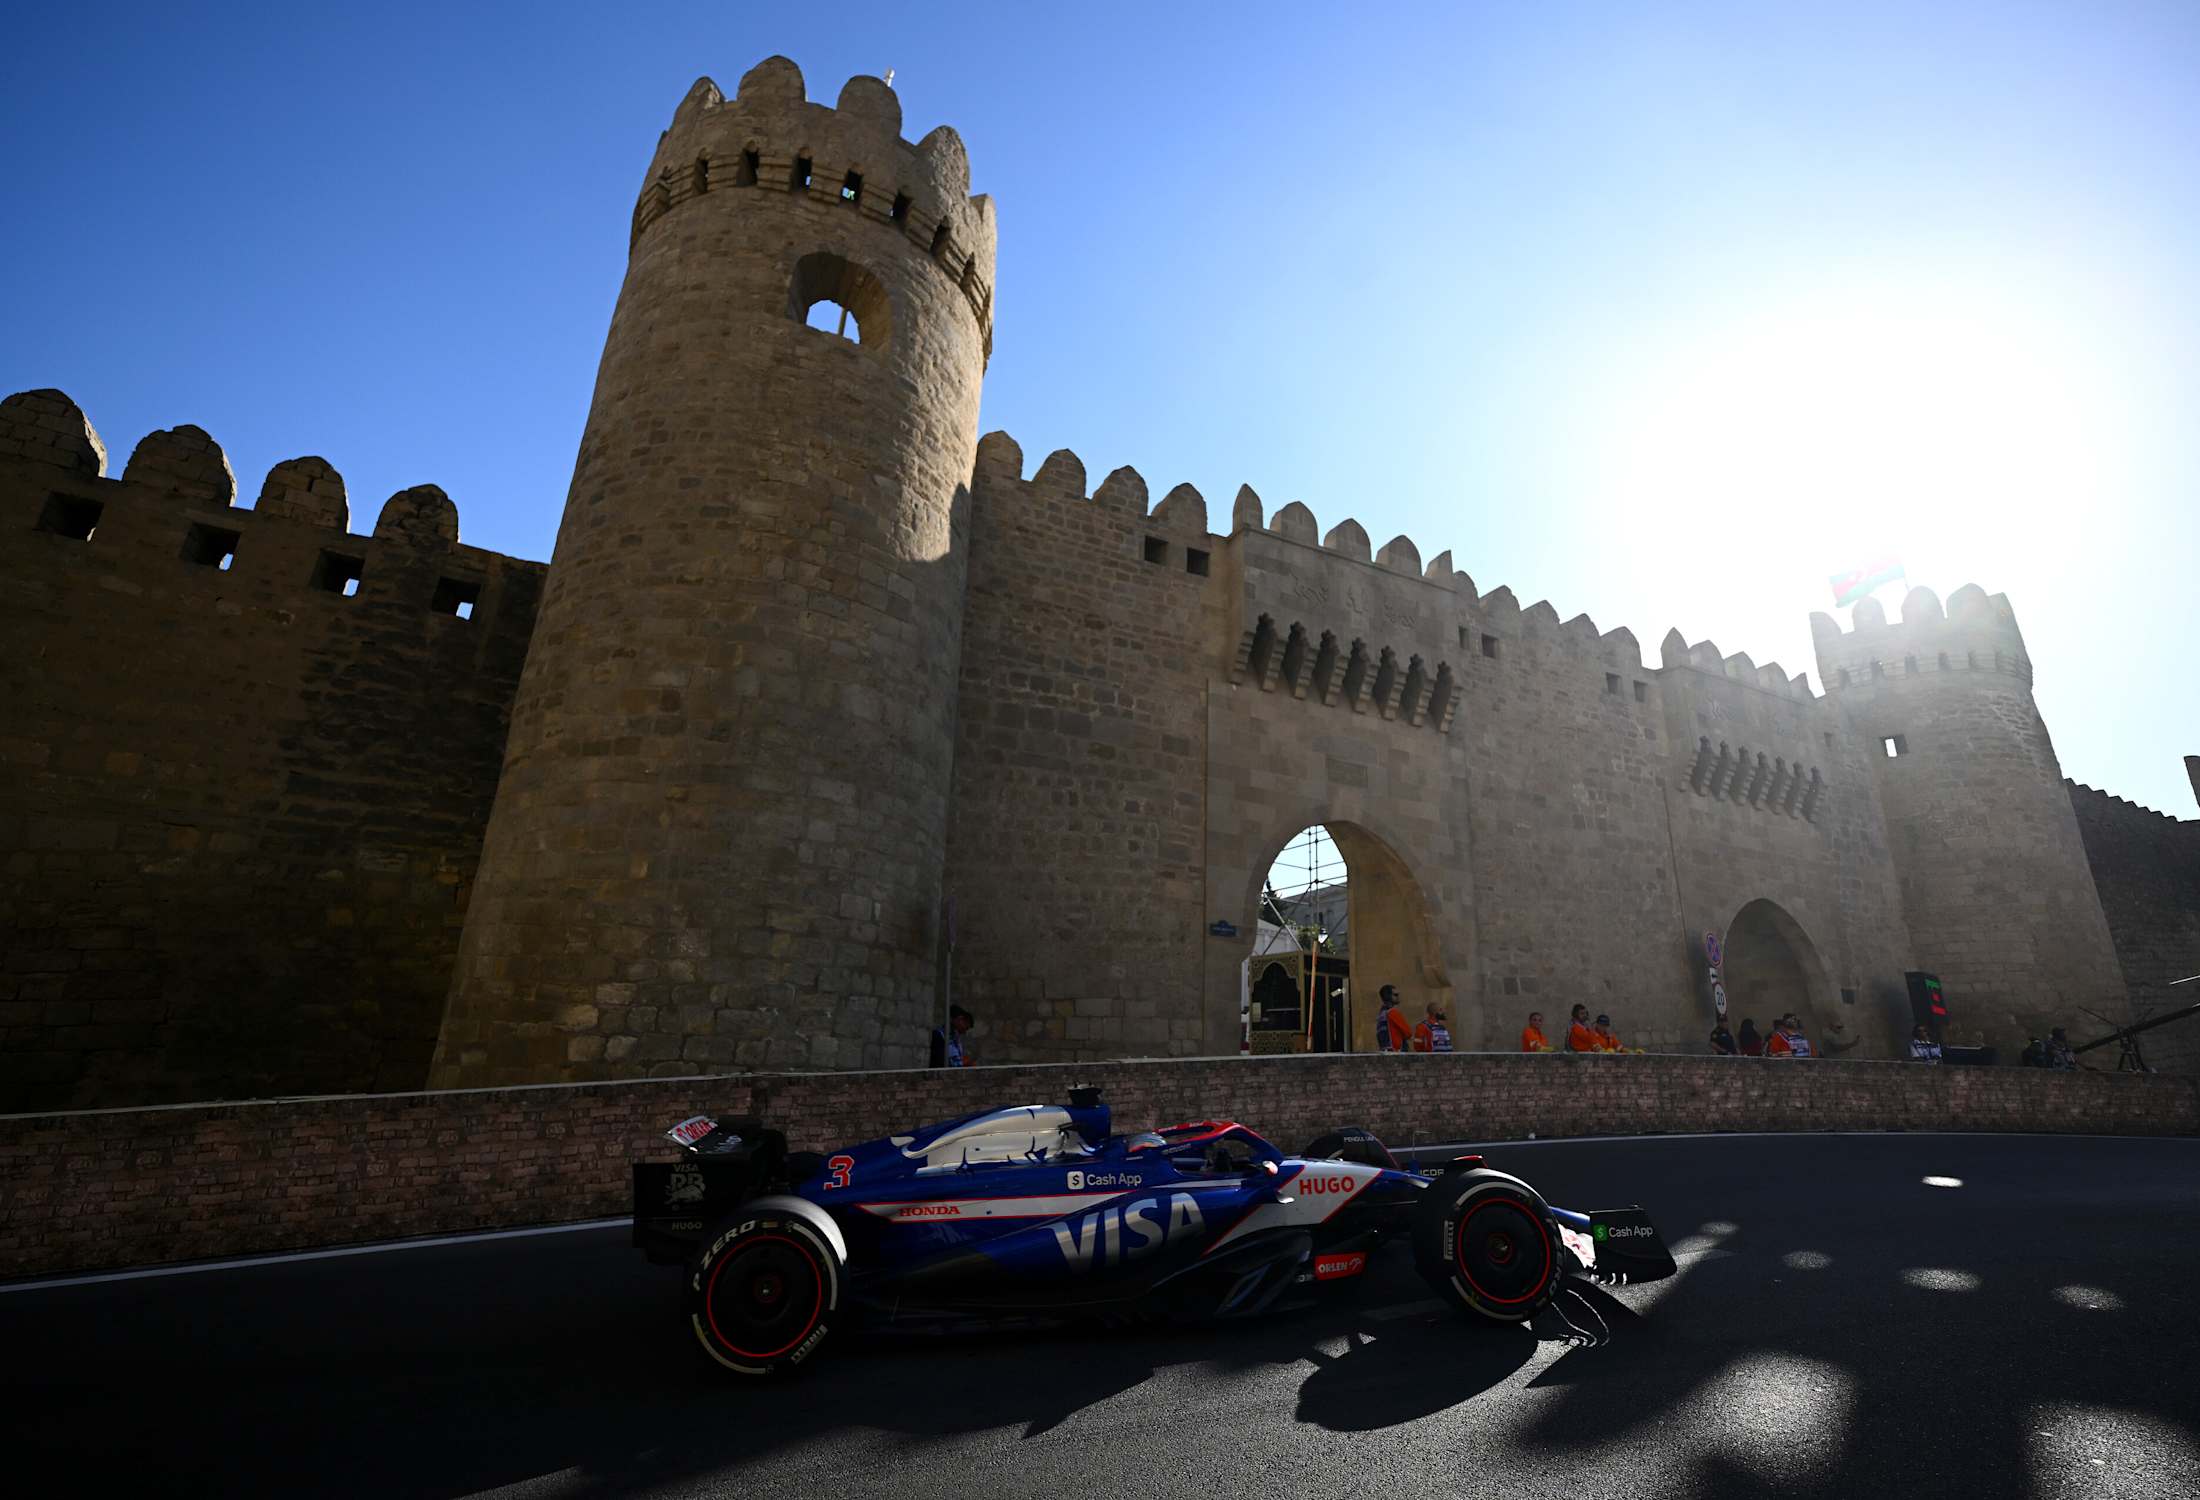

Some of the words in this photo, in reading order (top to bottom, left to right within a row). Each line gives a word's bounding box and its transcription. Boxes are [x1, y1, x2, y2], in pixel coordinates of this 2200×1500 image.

[1716, 991, 1725, 1006] 20
[673, 1163, 701, 1173] VISA
[822, 1154, 855, 1191] 3
[1086, 1173, 1117, 1186] Cash
[1117, 1173, 1143, 1187] App
[1299, 1176, 1355, 1196] HUGO
[899, 1205, 961, 1217] HONDA
[671, 1220, 704, 1231] HUGO
[1608, 1225, 1632, 1238] Cash
[1634, 1225, 1654, 1238] App
[1045, 1191, 1208, 1277] VISA
[701, 1219, 757, 1270] ZERO
[1318, 1261, 1349, 1274] ORLEN
